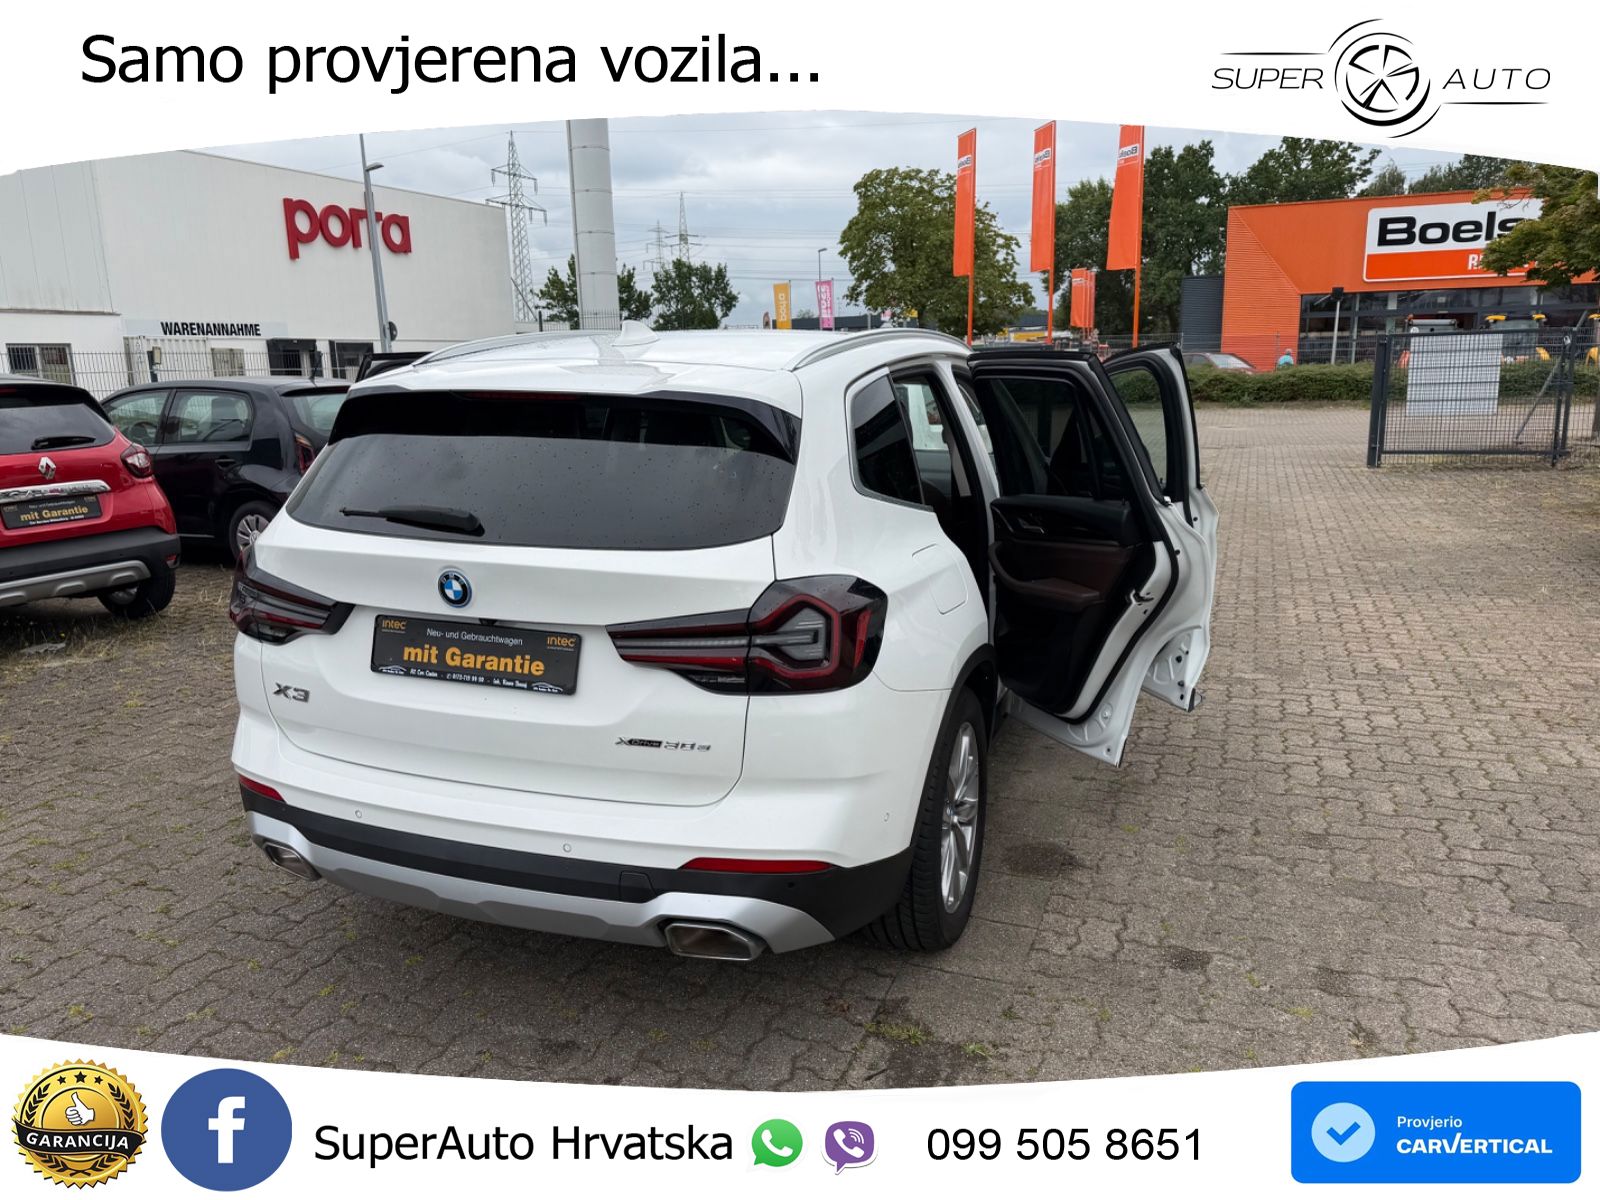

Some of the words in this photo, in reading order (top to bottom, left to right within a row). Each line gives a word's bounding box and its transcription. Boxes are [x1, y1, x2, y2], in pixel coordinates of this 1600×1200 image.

[283, 198, 412, 260] pora
[160, 321, 262, 337] WARENANNAHME
[20, 512, 40, 522] mit
[42, 505, 89, 519] Garantie
[426, 627, 444, 637] Neu-
[445, 631, 459, 639] und
[460, 631, 523, 647] Gebrauchtwagen
[403, 644, 438, 664] mit
[445, 646, 545, 676] Garantie
[273, 682, 310, 703] X3
